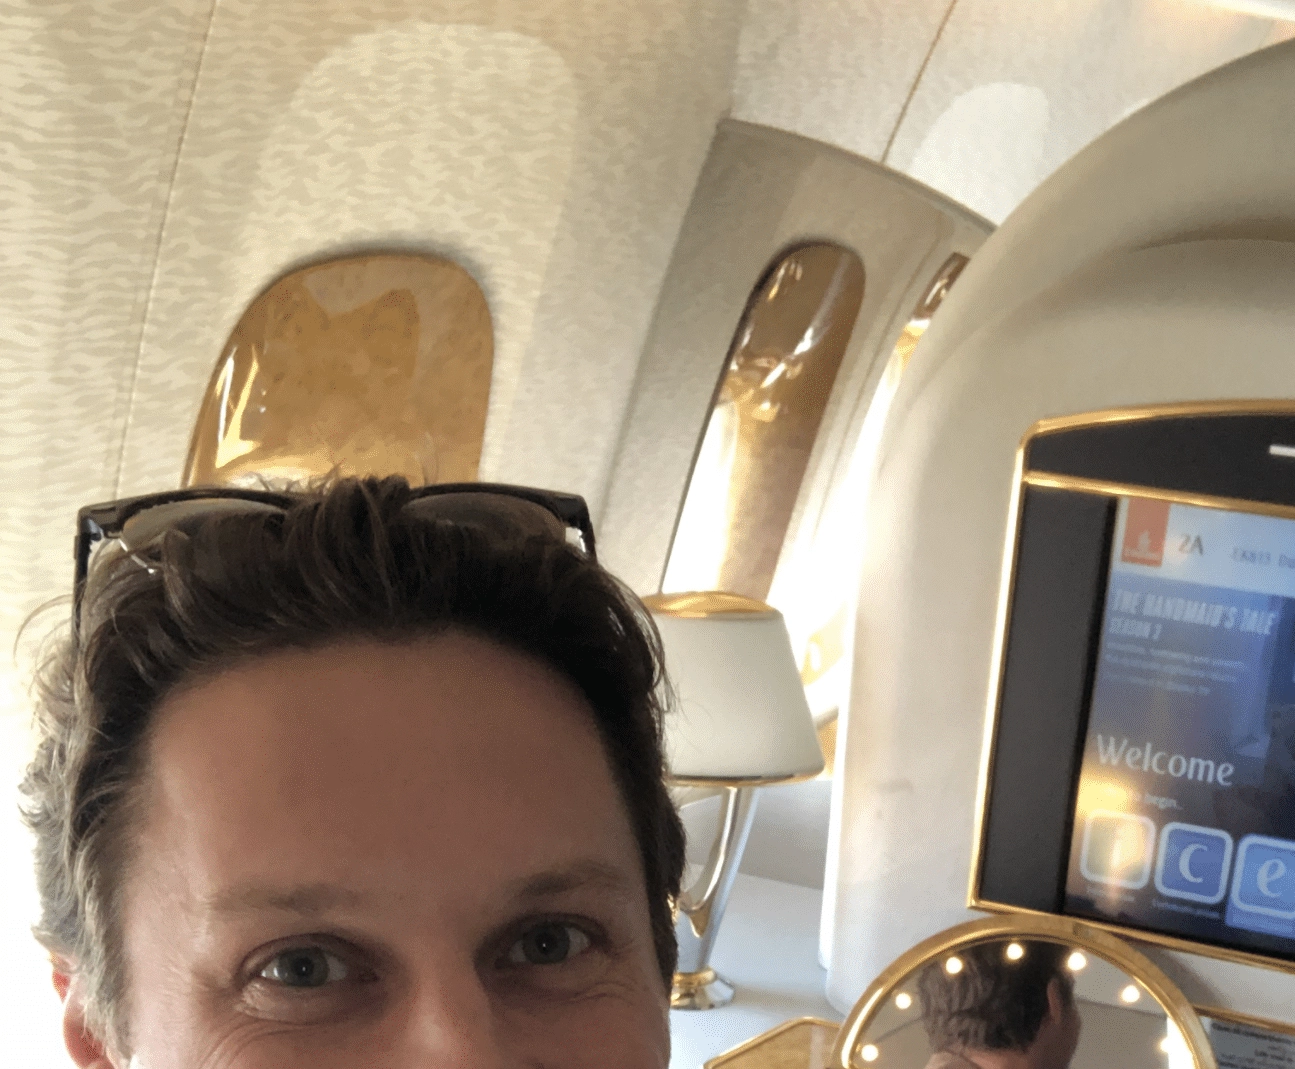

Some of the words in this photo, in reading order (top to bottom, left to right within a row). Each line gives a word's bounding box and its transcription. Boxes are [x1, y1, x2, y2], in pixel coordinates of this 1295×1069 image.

[1178, 533, 1203, 556] 2A
[1111, 588, 1138, 615] THE
[1142, 593, 1239, 630] HANDMAID'S
[1239, 607, 1279, 636] TALE
[1097, 734, 1235, 787] Welcome
[1257, 858, 1286, 898] e
